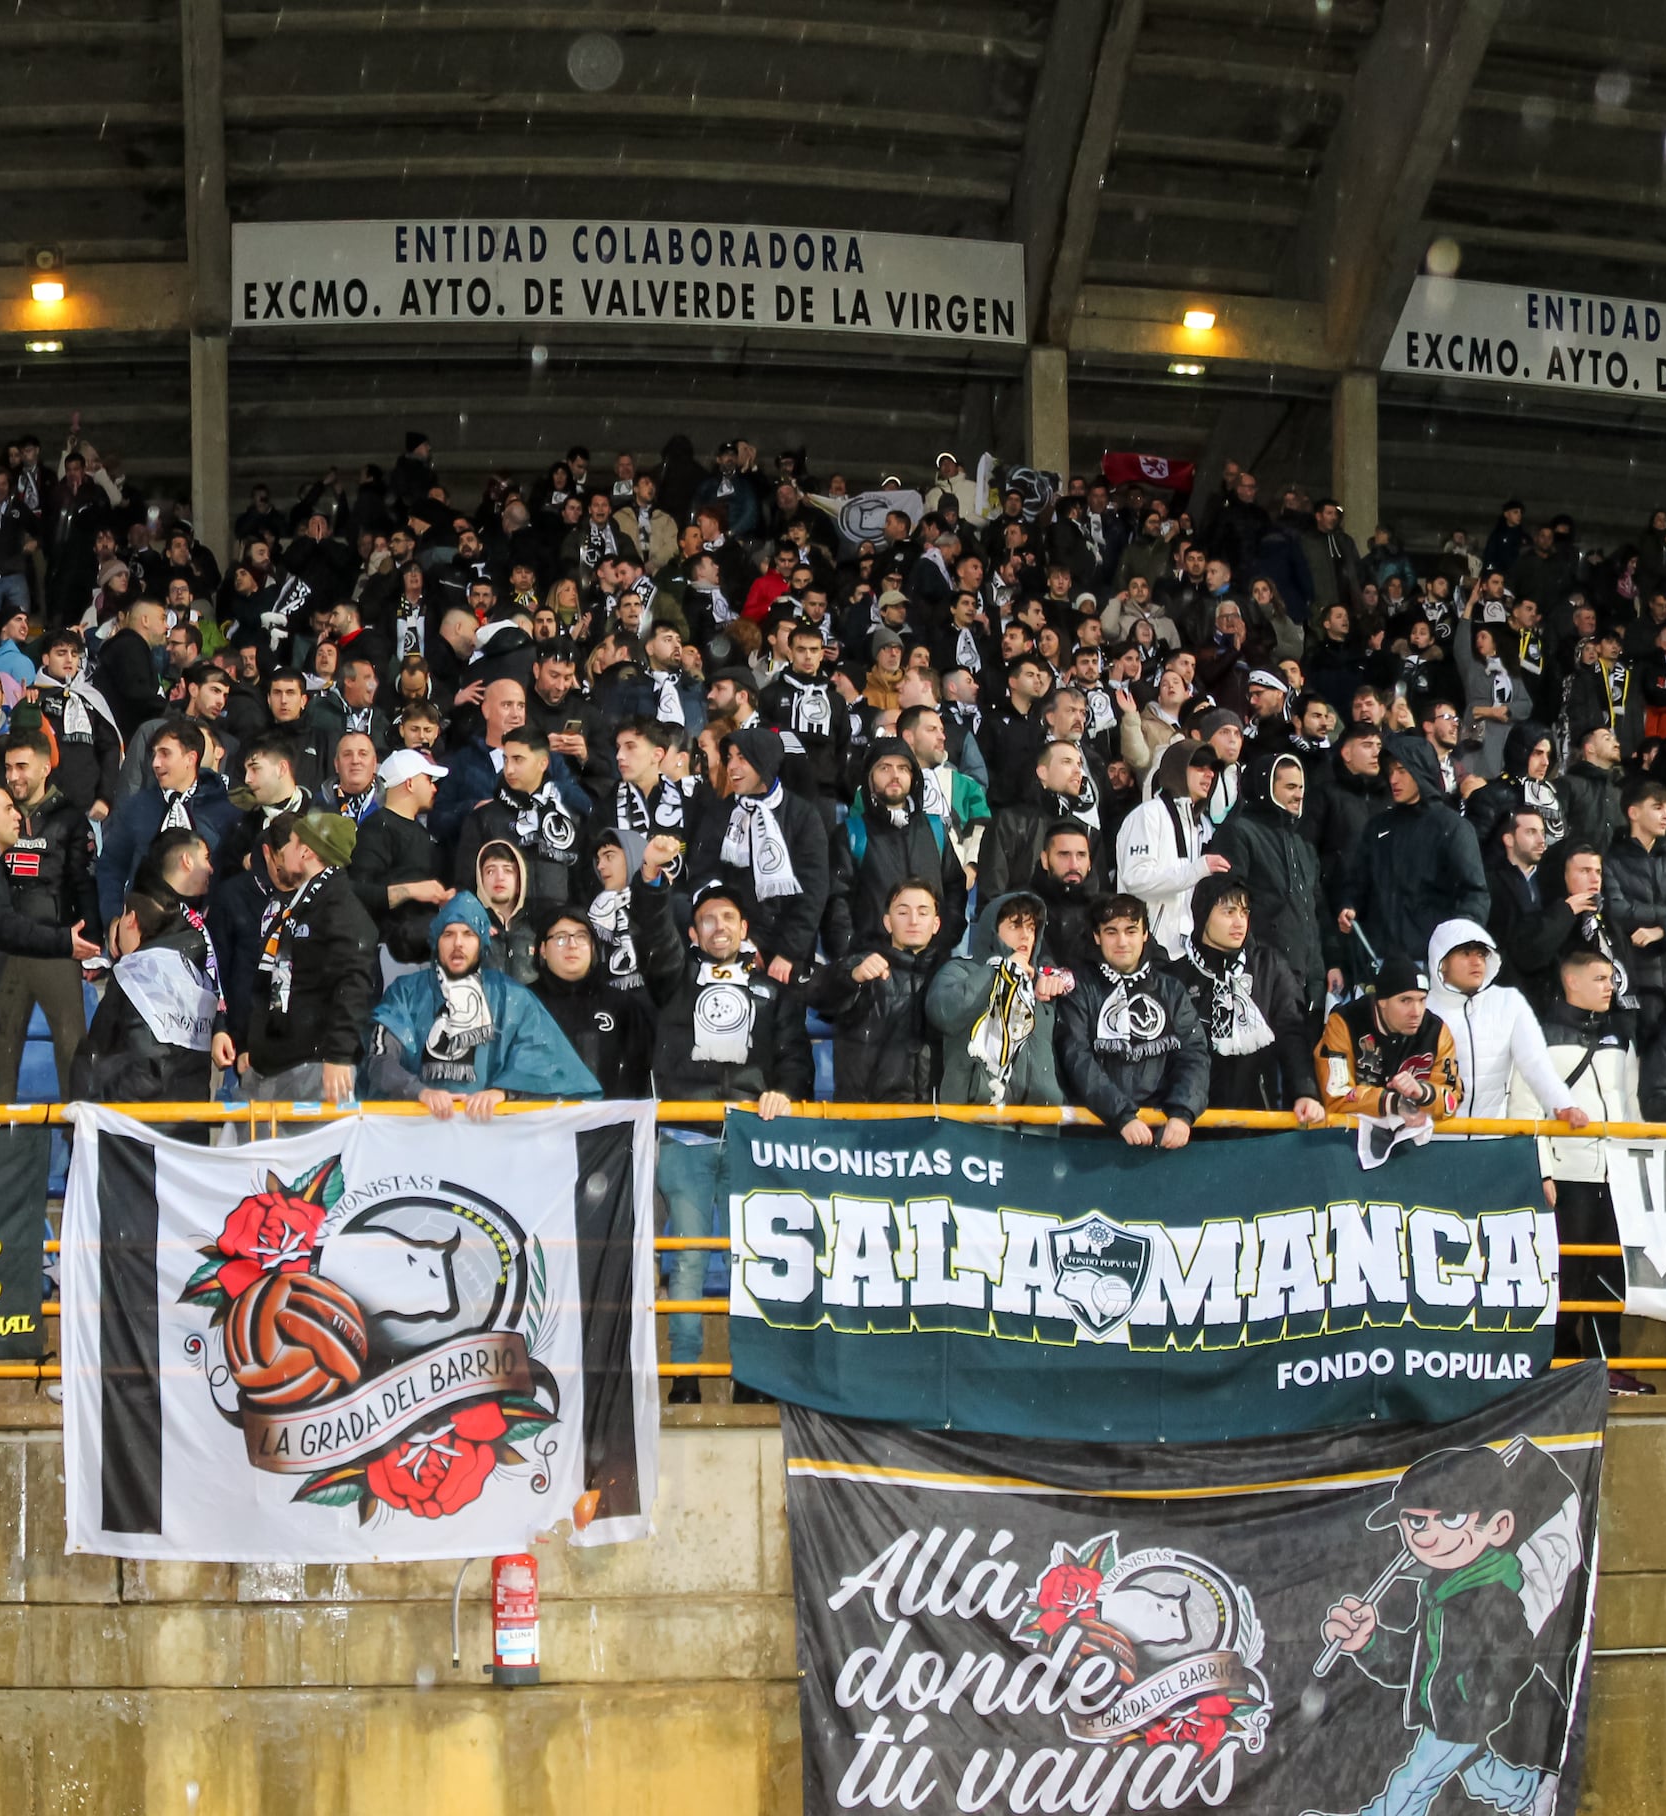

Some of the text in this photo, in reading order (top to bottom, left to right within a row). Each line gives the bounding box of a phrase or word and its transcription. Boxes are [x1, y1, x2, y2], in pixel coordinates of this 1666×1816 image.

[395, 225, 864, 274] ENTIDAD COLABORADORA
[244, 278, 1016, 338] EXCMO. AYTO. DE VALVERDE DE LA VIRGEN
[1527, 293, 1661, 342] ENTIDAD
[1406, 331, 1531, 380] EXCMO.
[1547, 346, 1640, 392] AYTO.
[749, 1140, 1004, 1186] UNIONISTAS CF
[741, 1188, 1551, 1350] SALAMANCA
[1277, 1348, 1532, 1390] FONDO POPULAR
[260, 1345, 517, 1457] LA GRADA DEL BARRIO
[827, 1527, 1025, 1623] Allá
[834, 1619, 1125, 1715] donde
[1152, 1678, 1179, 1704] DEL
[835, 1713, 1240, 1816] tú vayas
